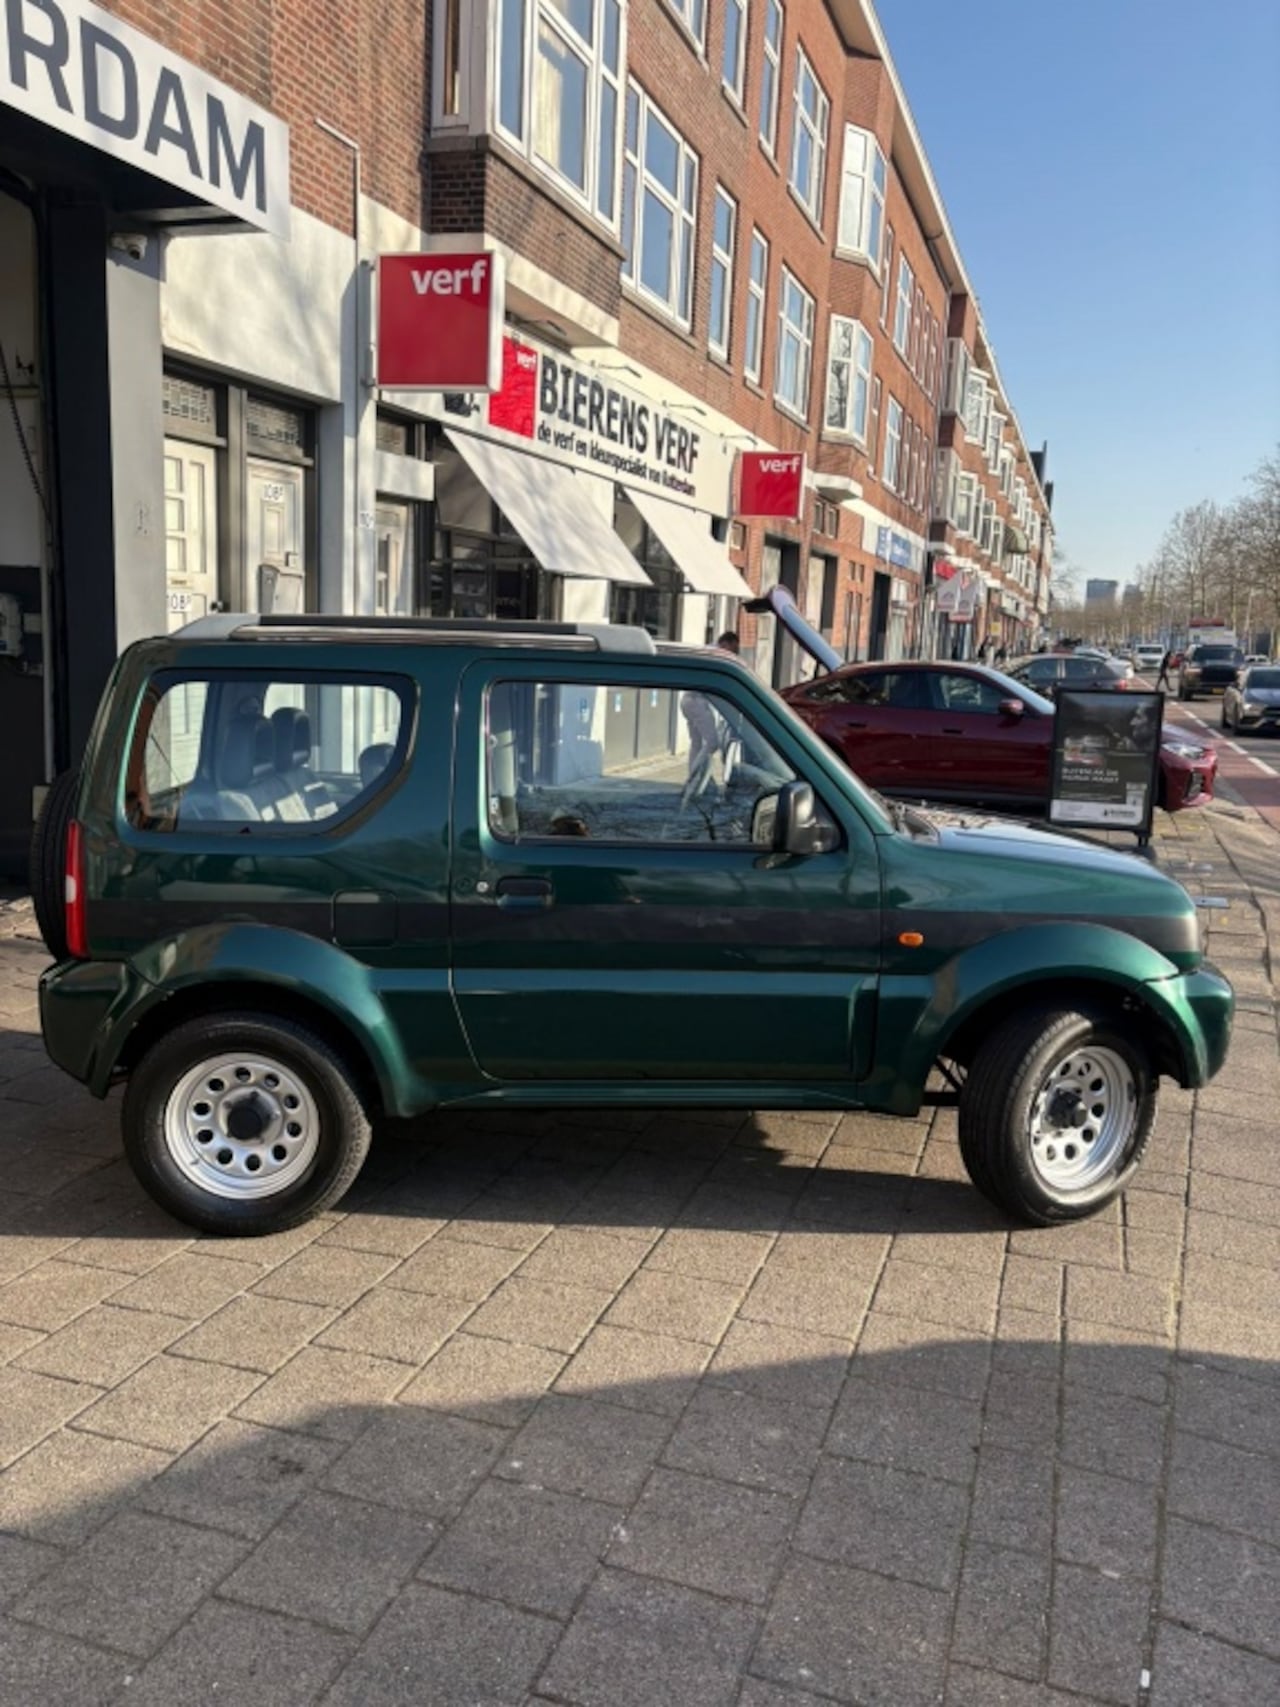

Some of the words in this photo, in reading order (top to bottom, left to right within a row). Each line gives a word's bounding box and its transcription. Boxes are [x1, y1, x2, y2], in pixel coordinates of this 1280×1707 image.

[5, 0, 267, 214] RDAM
[411, 260, 487, 295] verf
[539, 354, 648, 454] BIERENS
[653, 411, 700, 474] VERF
[537, 420, 552, 444] de
[553, 430, 575, 448] verf
[576, 438, 588, 457] en
[759, 456, 801, 474] verf
